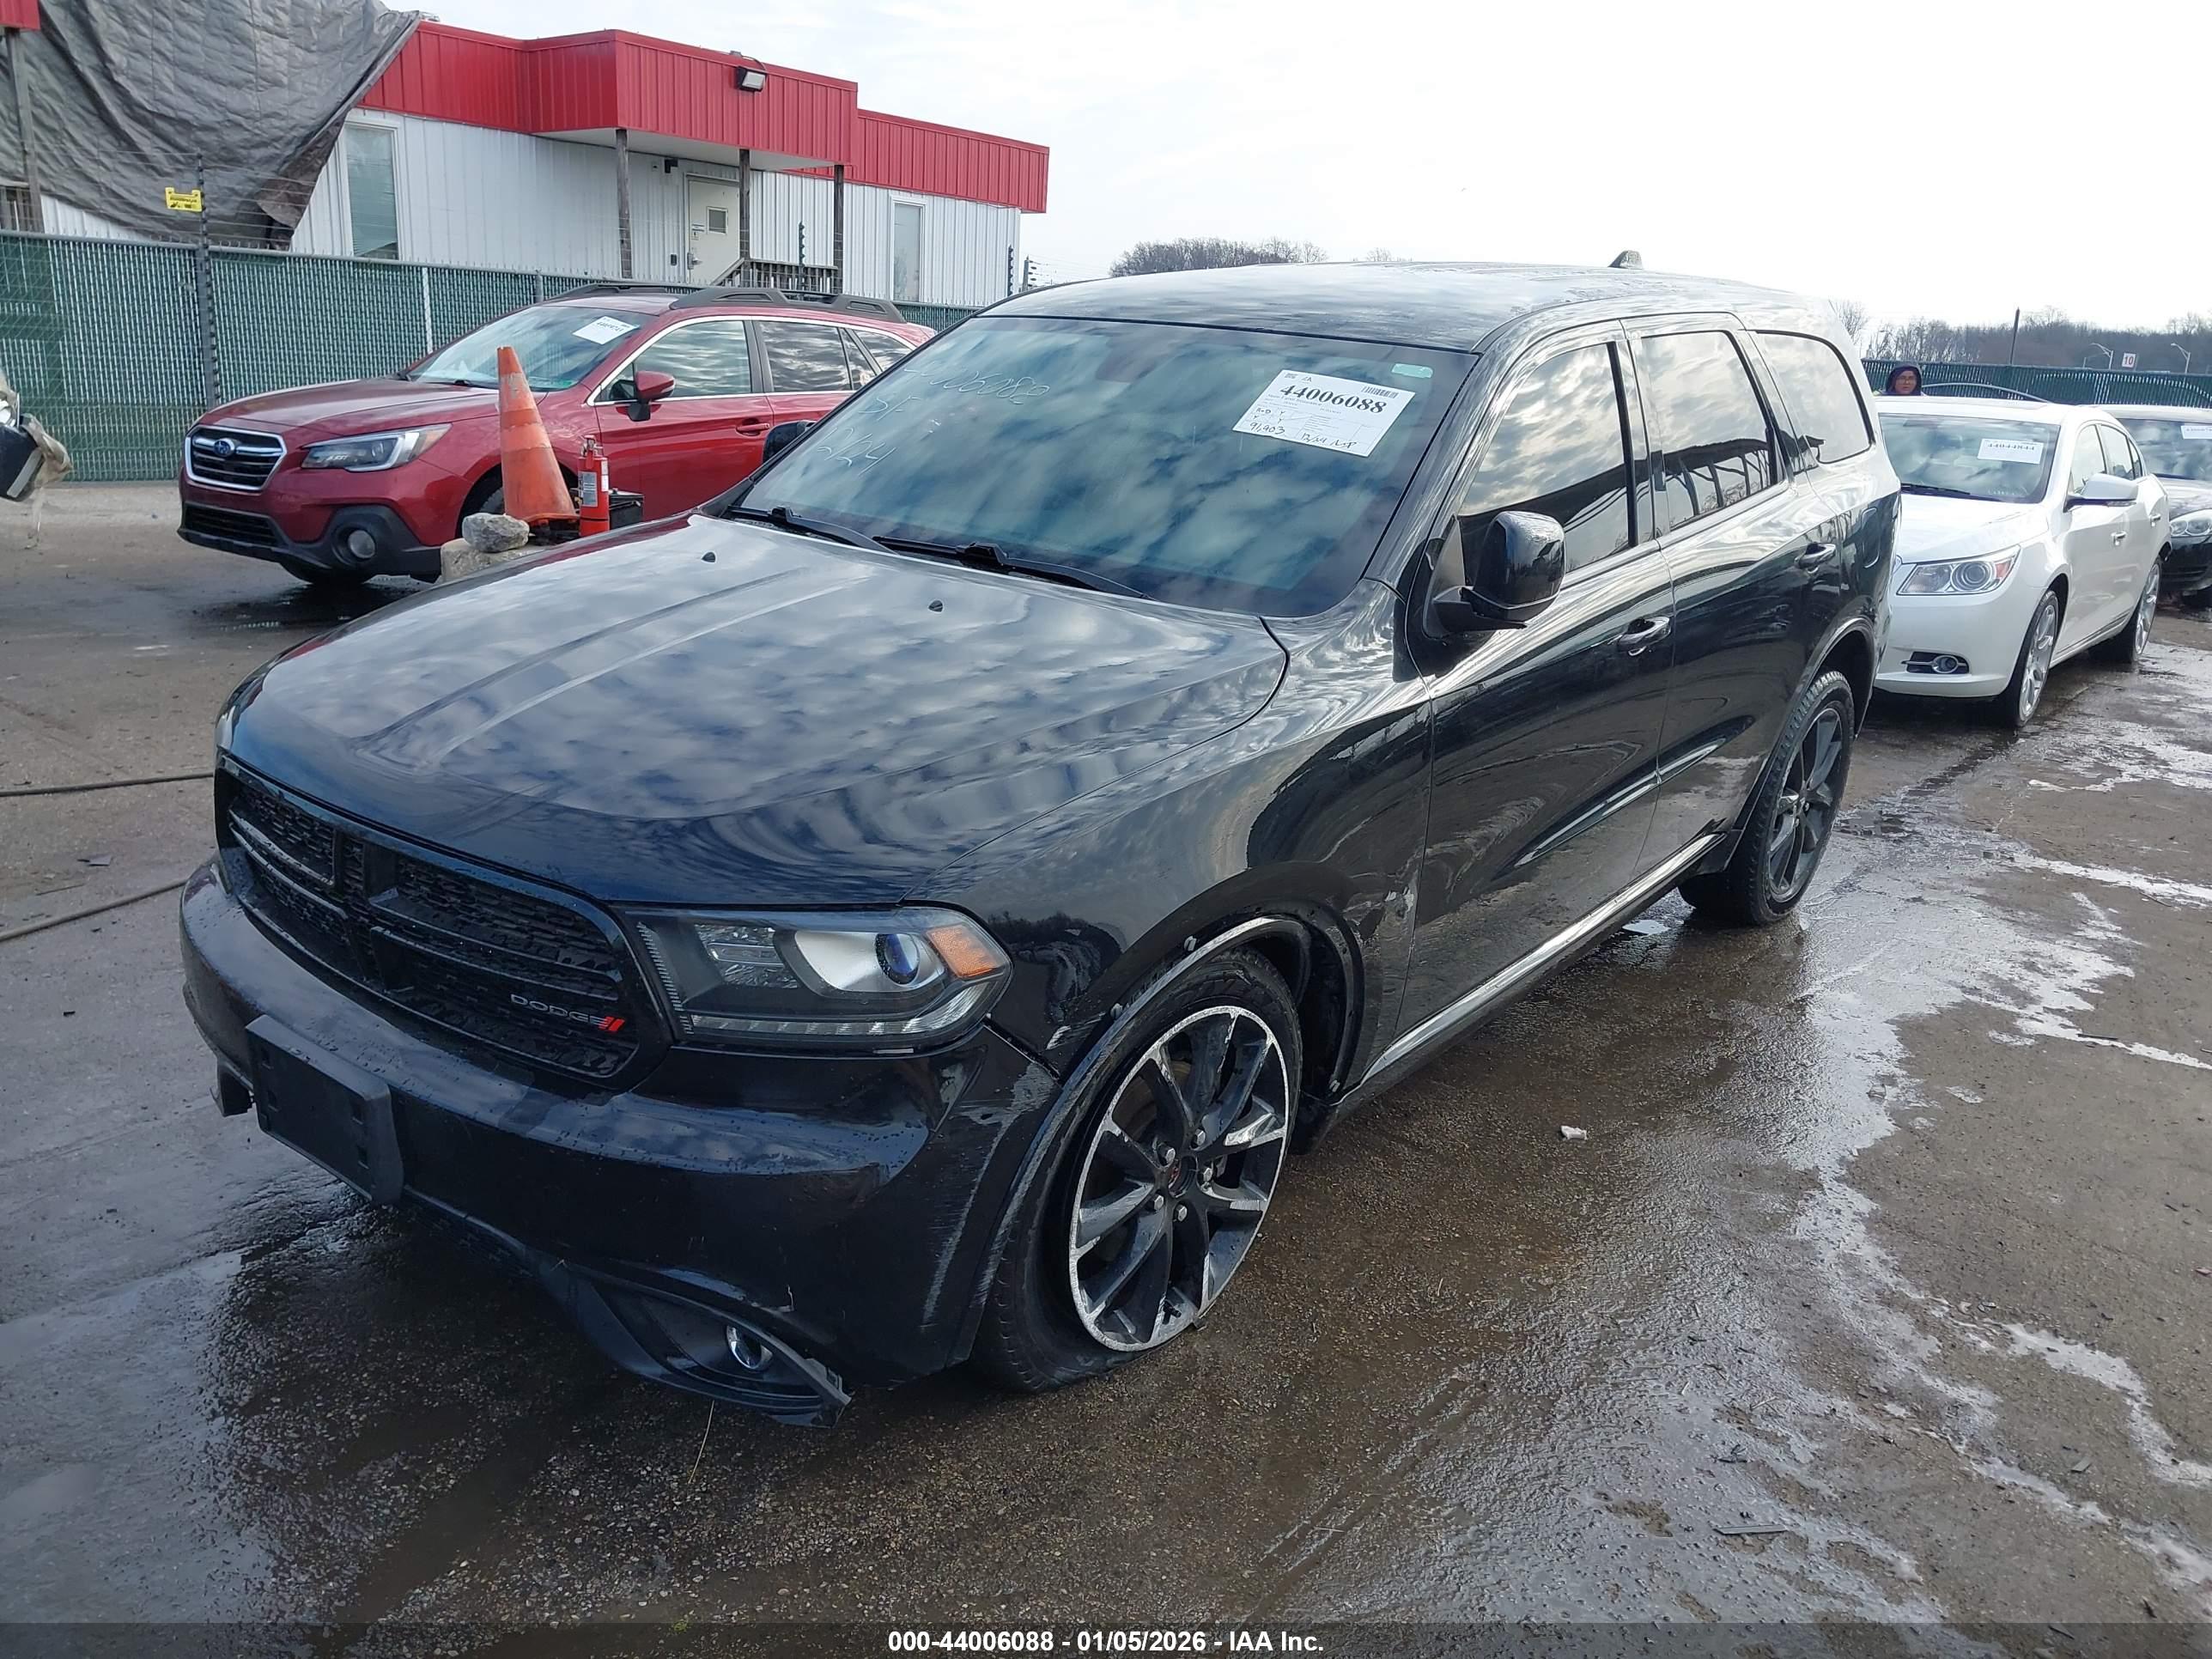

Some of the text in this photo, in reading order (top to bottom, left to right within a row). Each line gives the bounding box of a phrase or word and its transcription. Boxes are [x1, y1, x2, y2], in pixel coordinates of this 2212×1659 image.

[2124, 356, 2134, 365] 10
[1279, 385, 1388, 414] 44006088
[510, 994, 609, 1028] DODGE
